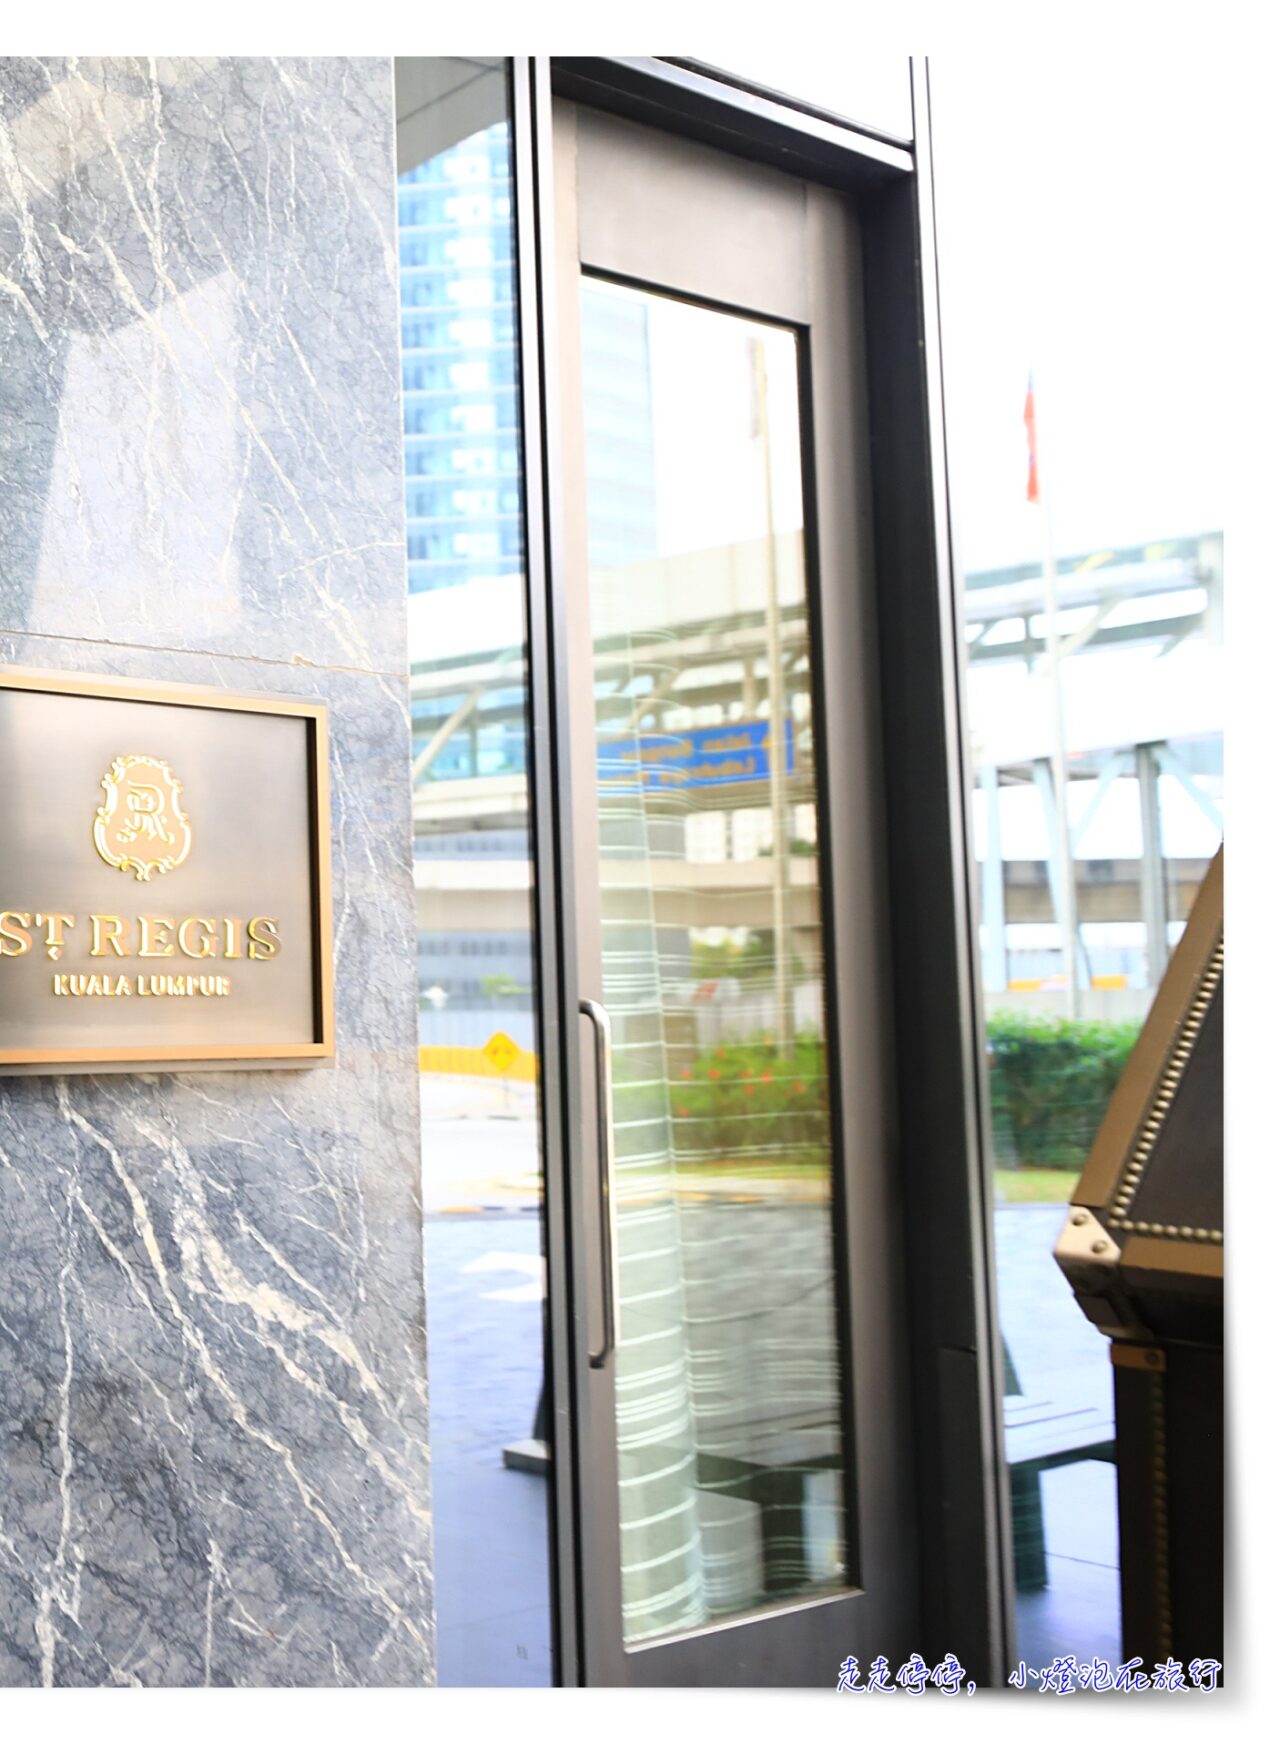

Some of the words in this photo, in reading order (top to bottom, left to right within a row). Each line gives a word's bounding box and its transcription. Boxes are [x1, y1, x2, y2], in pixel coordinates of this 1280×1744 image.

[89, 914, 283, 960] REGIS
[52, 973, 132, 997] KUALA
[136, 973, 231, 997] LUMPUR
